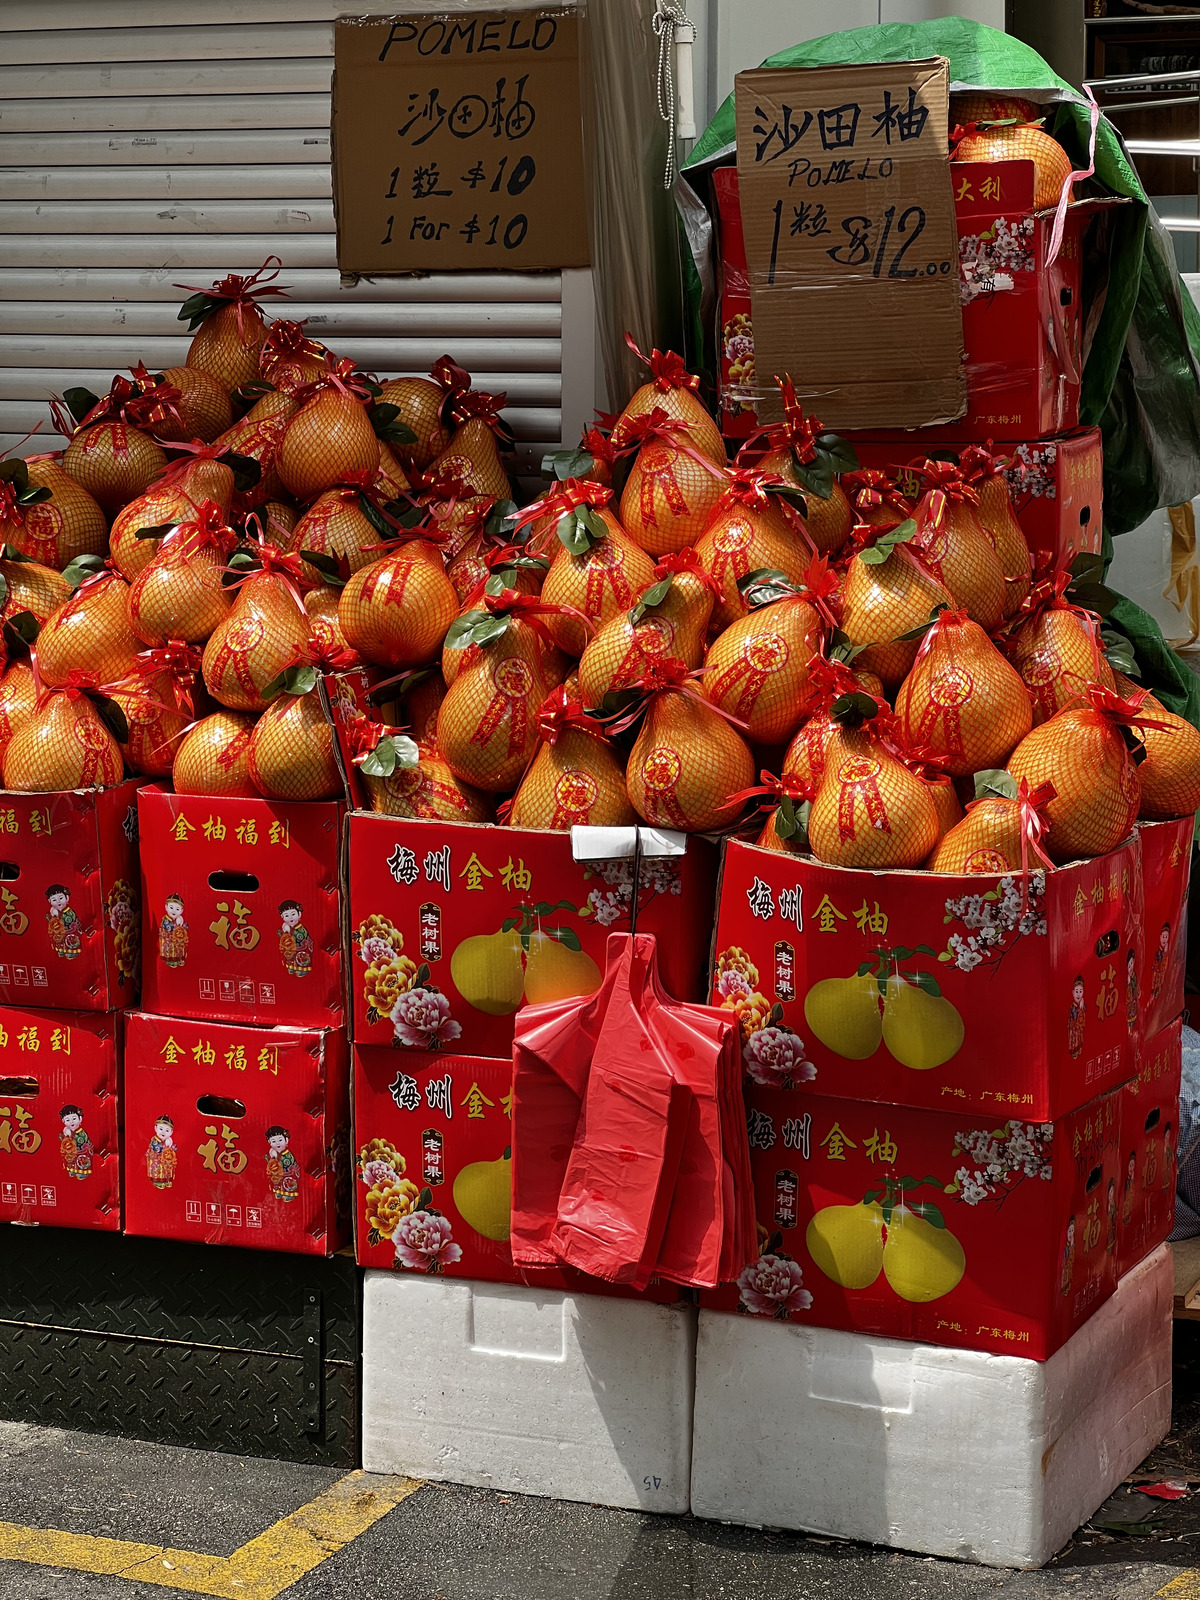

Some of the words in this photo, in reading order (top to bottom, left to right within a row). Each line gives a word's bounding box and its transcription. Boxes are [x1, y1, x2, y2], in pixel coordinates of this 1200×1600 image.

[378, 18, 557, 62] POMELO
[398, 74, 536, 146] 沙田柚
[754, 87, 930, 164] 沙田柚
[460, 155, 536, 196] $10
[788, 158, 894, 187] POMELO
[955, 176, 1000, 202] 大利
[380, 215, 395, 245] 1
[409, 216, 450, 241] For
[459, 213, 528, 249] $10
[973, 414, 1022, 425] 广东梅州
[169, 812, 290, 849] 金柚福到
[386, 844, 533, 892] 梅州金柚
[746, 876, 889, 936] 梅州金柚
[1072, 870, 1131, 917] 金柚福到
[208, 899, 261, 951] 福
[421, 912, 440, 954] 老树果
[775, 951, 794, 994] 老树果
[1095, 963, 1119, 1023] 福
[160, 1035, 279, 1076] 金柚福到
[197, 1123, 249, 1176] 福
[1072, 1101, 1114, 1157] 金柚福到
[424, 1138, 442, 1178] 老树果
[775, 1178, 796, 1221] 老树果
[1083, 1198, 1101, 1254] 福
